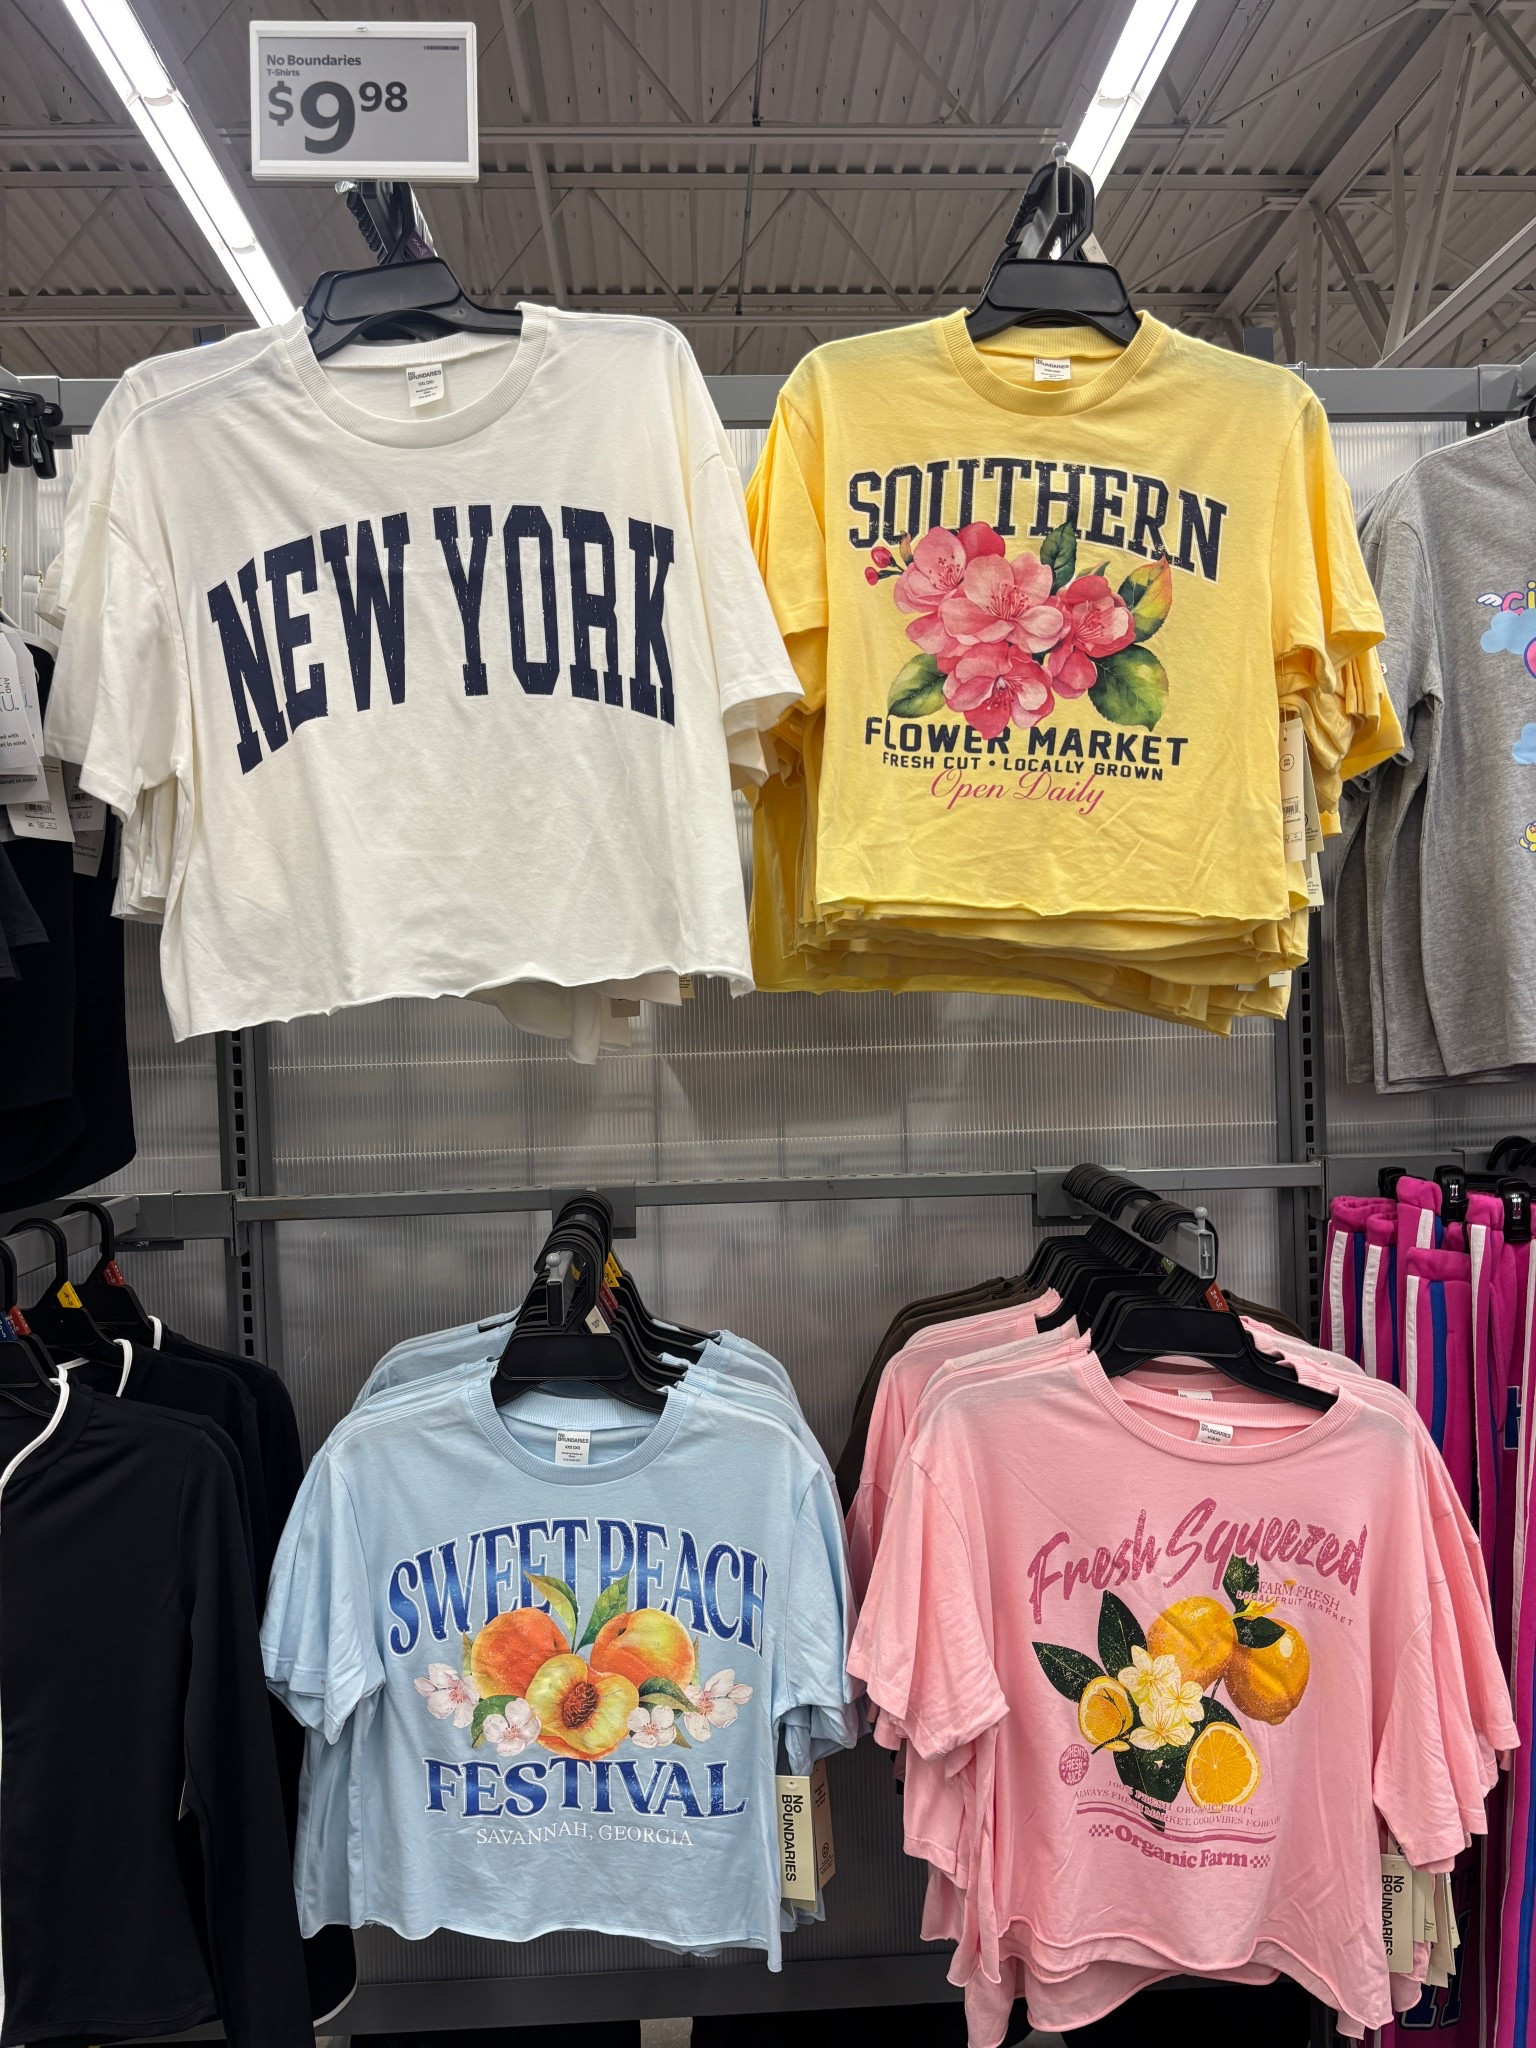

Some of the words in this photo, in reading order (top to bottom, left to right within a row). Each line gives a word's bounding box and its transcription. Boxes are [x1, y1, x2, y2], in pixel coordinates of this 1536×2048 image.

[266, 68, 300, 77] T-Shirts
[267, 54, 285, 66] No
[287, 53, 362, 66] Boundaries
[408, 370, 441, 381] BOUNDARIES
[847, 456, 1230, 583] SOUTHERN
[207, 511, 411, 776] NEW
[432, 503, 676, 728] YORK
[864, 716, 1011, 755] FLOWER
[1027, 725, 1189, 767] MARKET
[882, 751, 935, 770] FRESH
[943, 756, 981, 771] CUT
[1002, 758, 1086, 775] LOCALLY
[1093, 762, 1164, 781] GROWN
[930, 767, 1009, 810] Open
[1012, 769, 1106, 816] Daily
[1201, 1427, 1231, 1438] BOUNDARIES
[1027, 1508, 1163, 1625] Fresh
[1162, 1497, 1368, 1596] Squeezed
[386, 1517, 590, 1656] SWEET
[596, 1517, 768, 1658] PEACH
[1258, 1581, 1293, 1596] FARM
[1295, 1585, 1341, 1612] FRESH
[1236, 1590, 1271, 1603] LOCAL
[1275, 1596, 1303, 1606] FRUIT
[1307, 1601, 1354, 1626] MARKET
[1065, 1758, 1083, 1772] FRESH
[423, 1756, 749, 1818] FESTIVAL
[793, 1794, 804, 1814] NO
[1135, 1790, 1172, 1811] FRESH
[1221, 1803, 1256, 1815] FRUIT
[1073, 1788, 1110, 1799] ALWAYS
[1111, 1791, 1144, 1811] FRESH
[1193, 1816, 1215, 1826] GOOD
[1216, 1815, 1244, 1825] VIBES
[476, 1820, 594, 1846] SAVANNAH,
[598, 1823, 694, 1847] GEORGIA
[781, 1794, 797, 1882] BOUNDARIES
[1114, 1824, 1198, 1869] Organic
[1199, 1848, 1249, 1868] Farm
[1393, 1875, 1405, 1893] NO
[1381, 1874, 1393, 1956] BOUNDARIES
